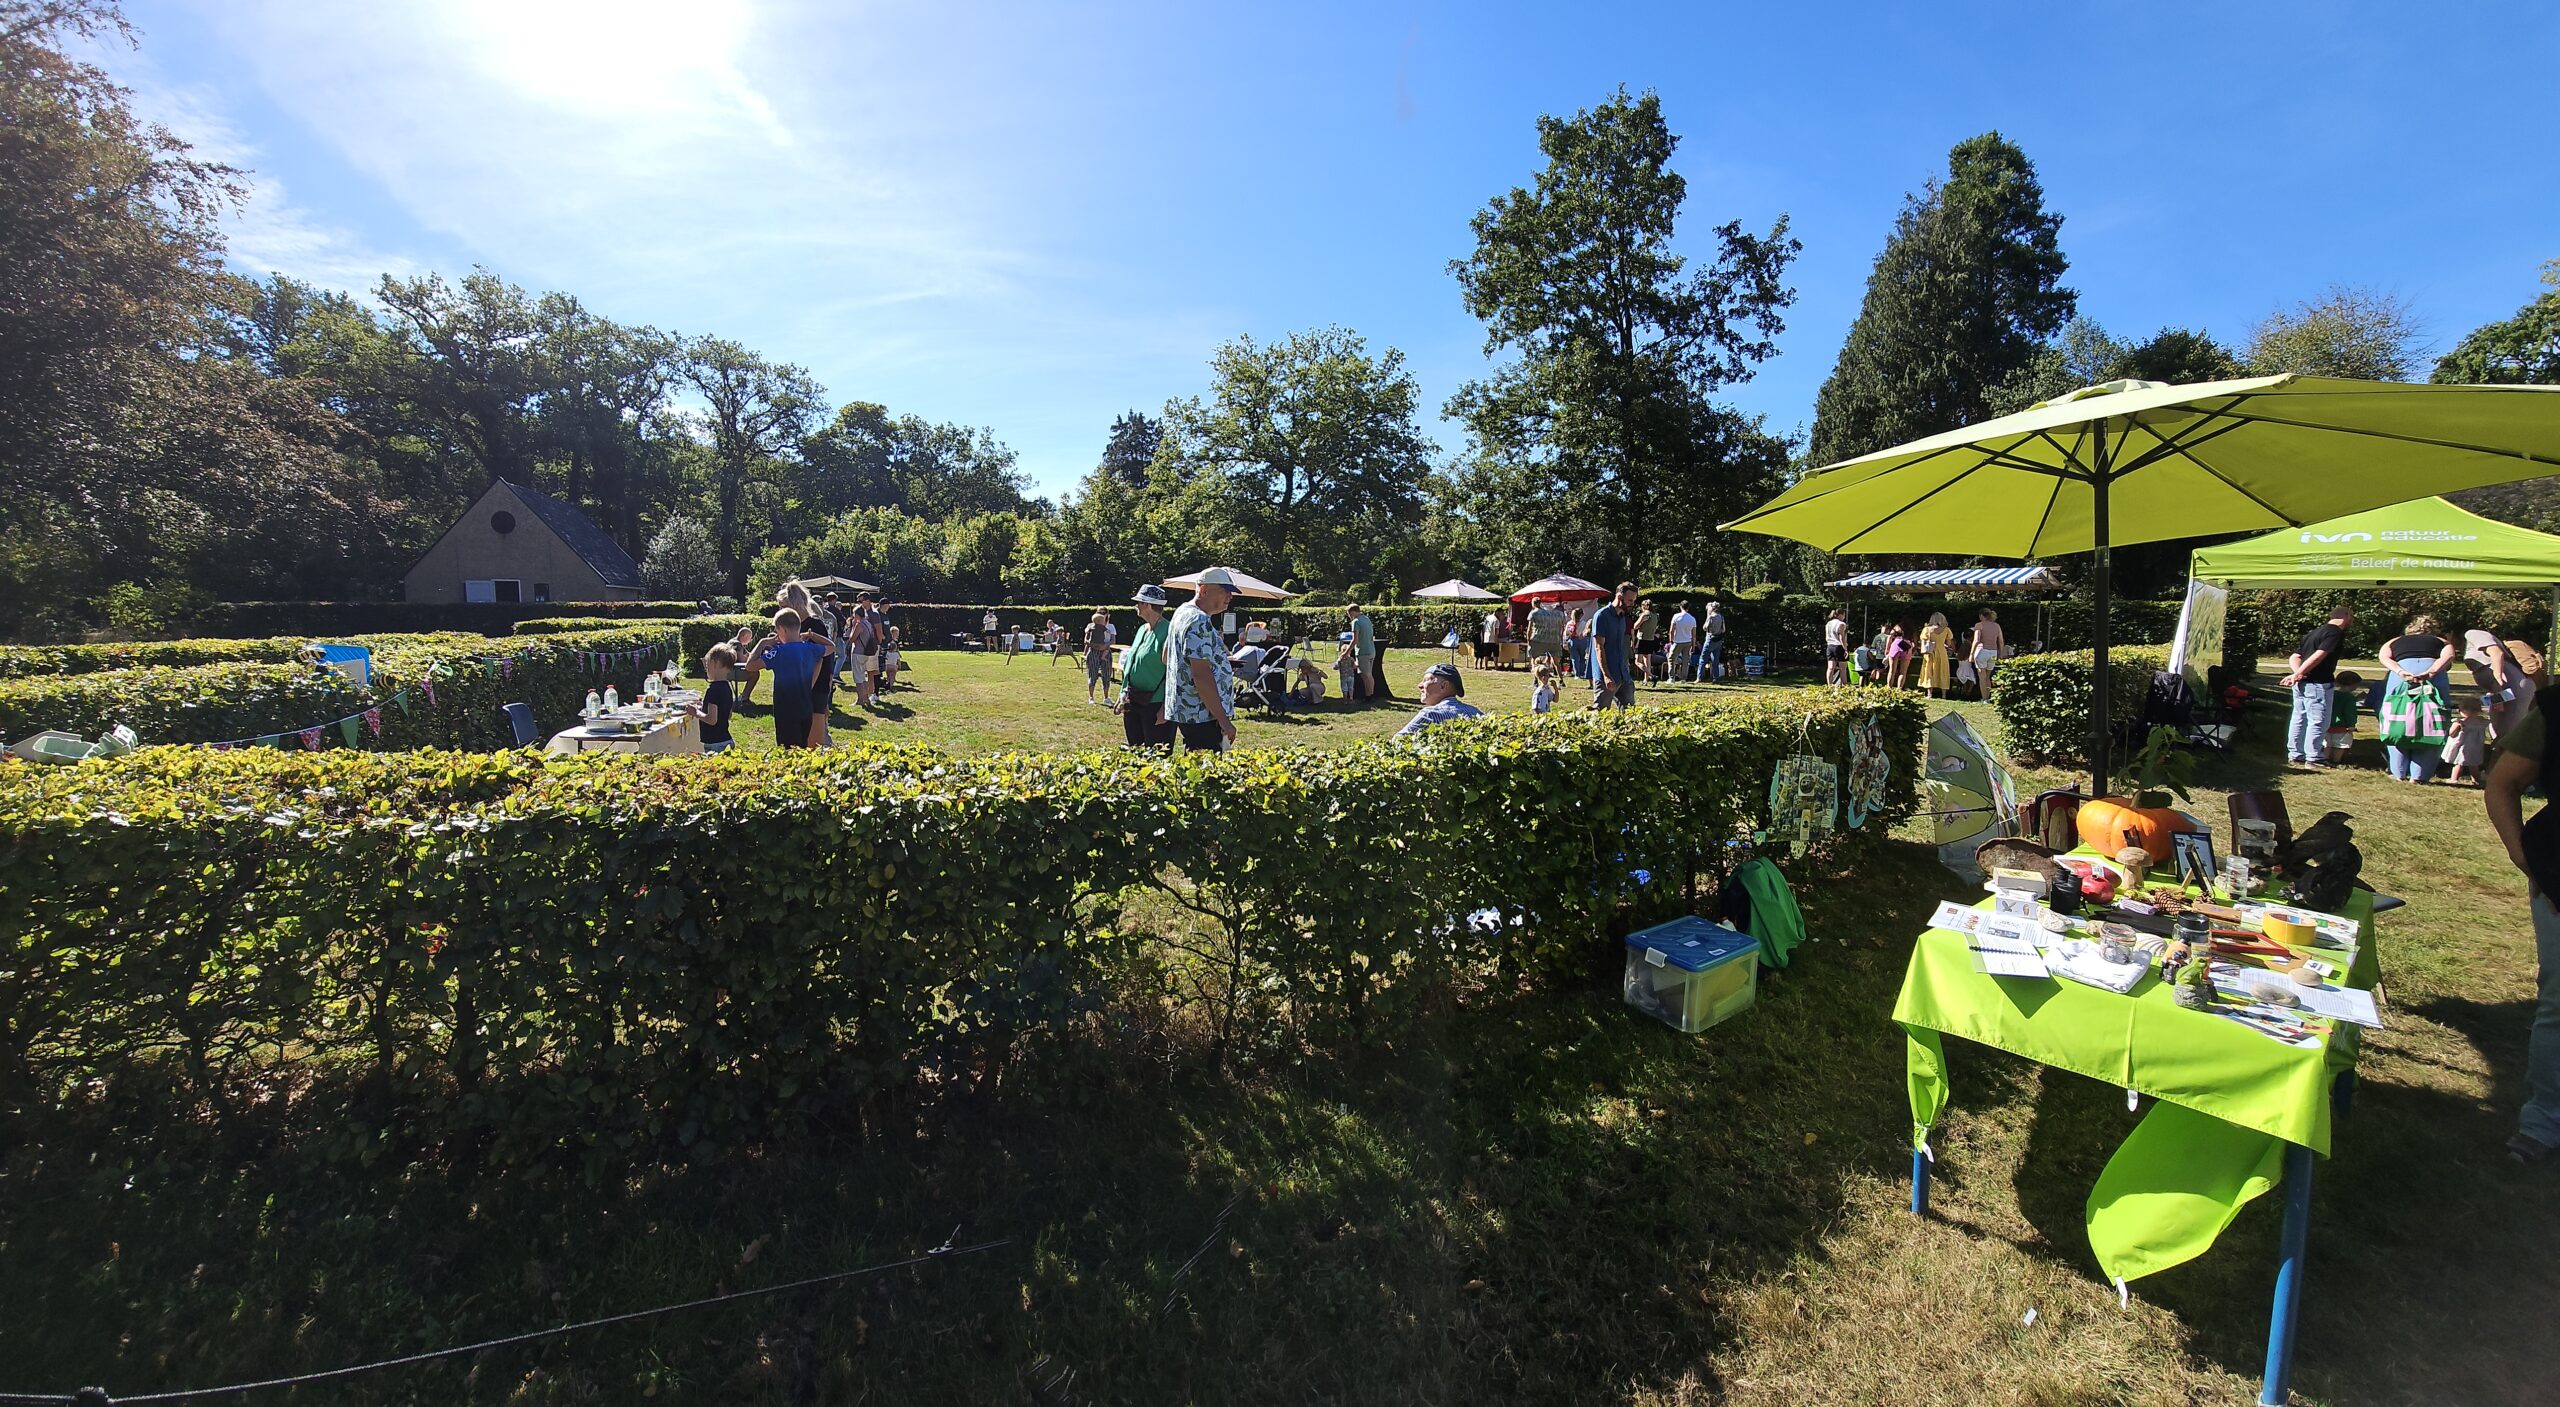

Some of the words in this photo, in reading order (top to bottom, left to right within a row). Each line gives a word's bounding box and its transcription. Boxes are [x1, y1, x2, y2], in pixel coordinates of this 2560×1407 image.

[2300, 531, 2372, 543] ivn
[2351, 558, 2397, 570] Beleef
[2400, 558, 2418, 568] de
[2423, 560, 2475, 568] natuur
